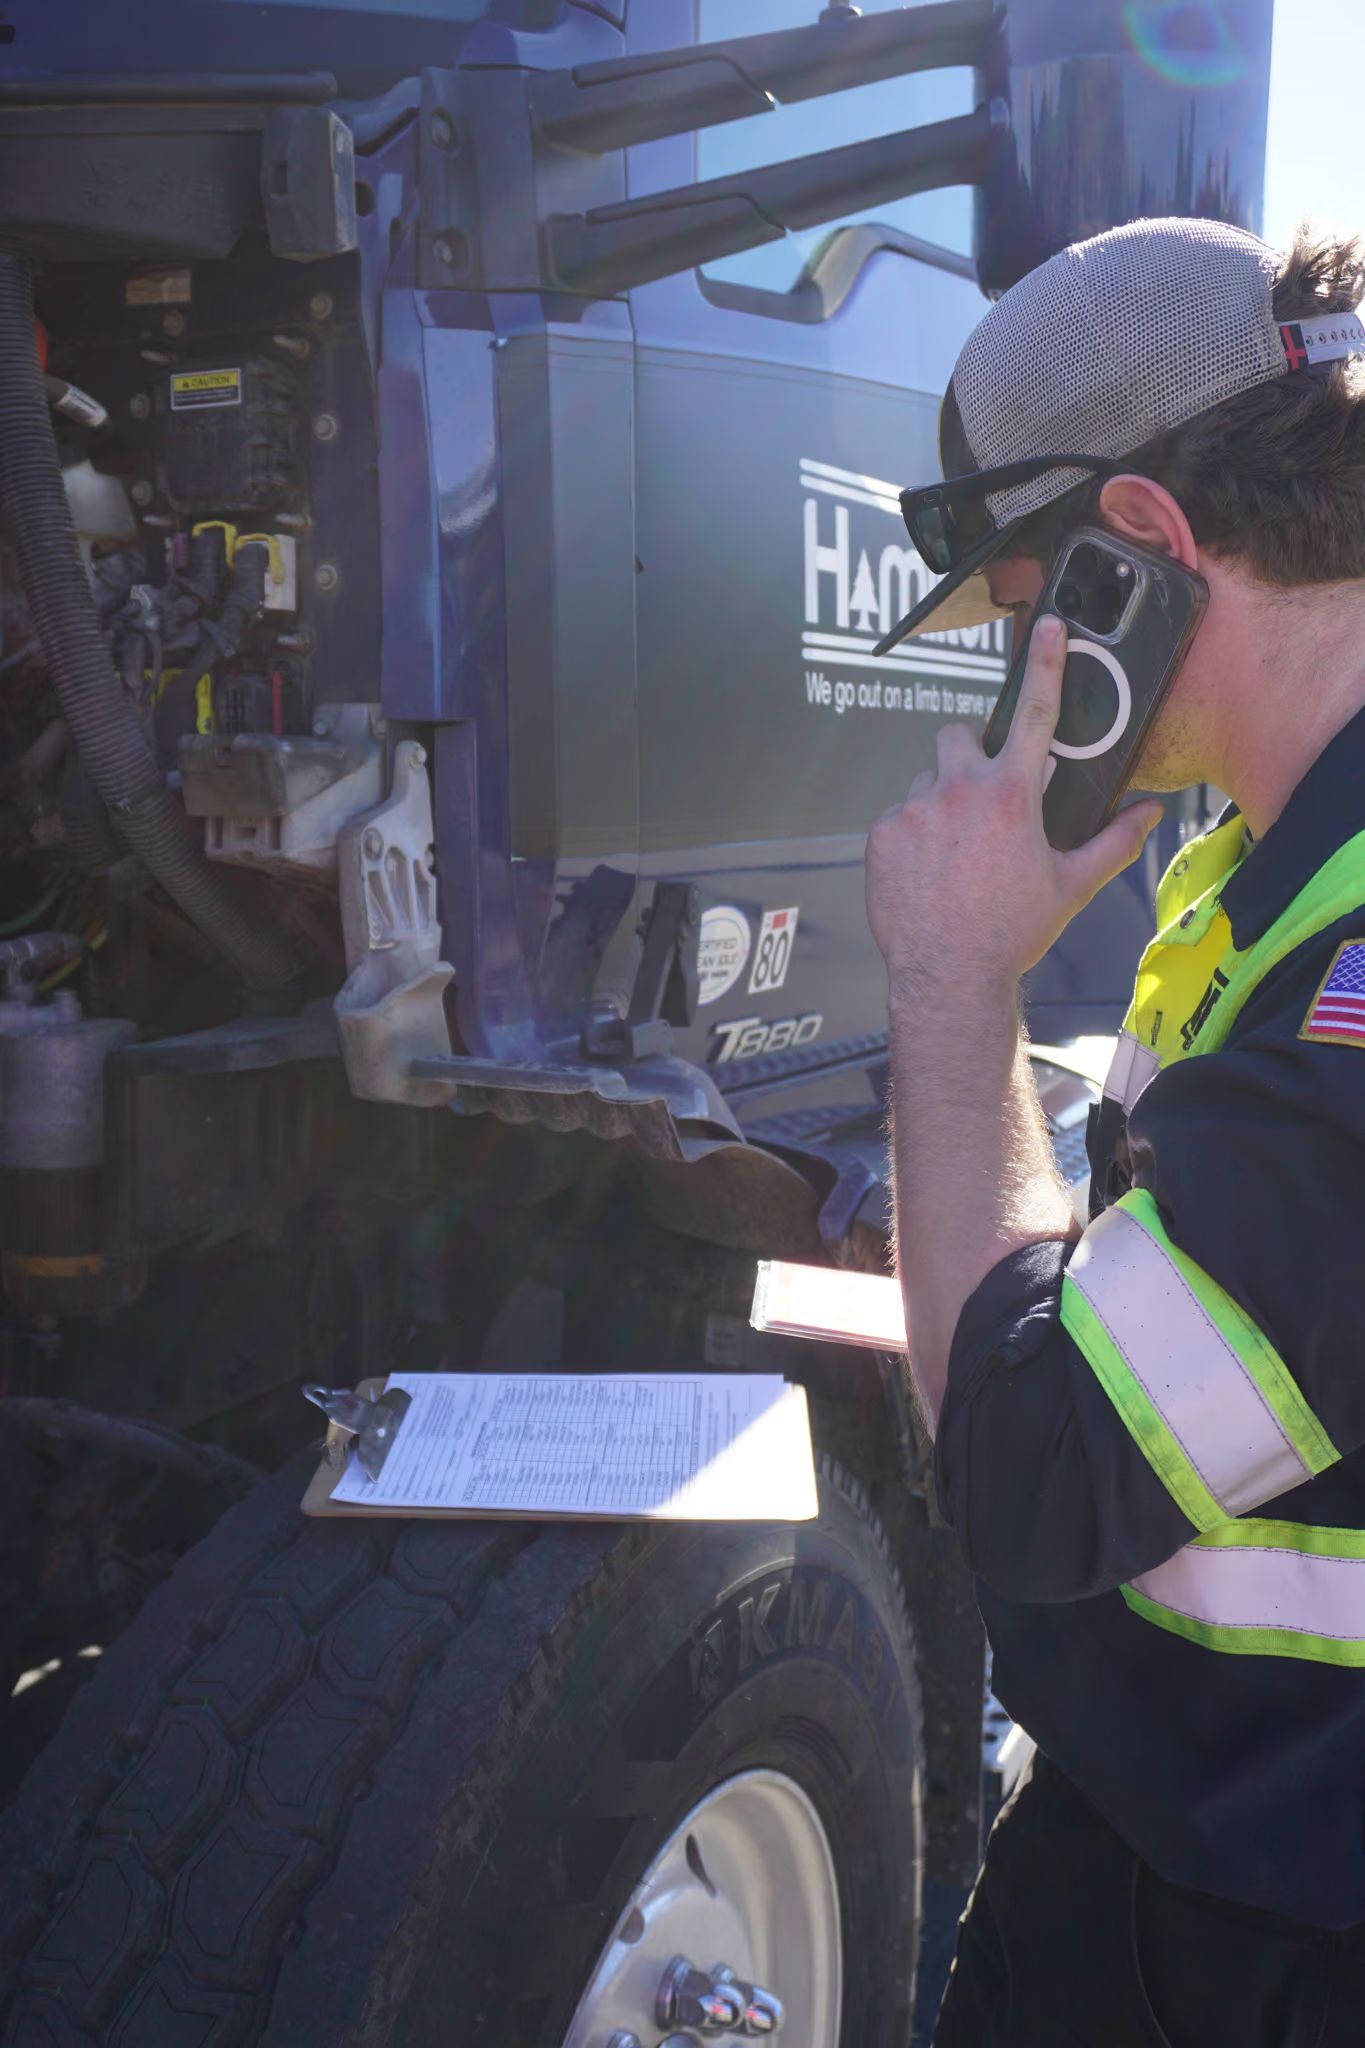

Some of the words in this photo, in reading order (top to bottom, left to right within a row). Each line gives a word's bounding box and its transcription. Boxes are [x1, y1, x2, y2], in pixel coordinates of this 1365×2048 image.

[191, 375, 230, 387] CAUTION
[805, 671, 832, 705] We
[834, 681, 855, 714] go
[858, 679, 881, 708] out
[884, 685, 902, 710] on
[904, 687, 913, 711] a
[914, 682, 940, 712] limb
[942, 684, 955, 713] to
[753, 930, 789, 988] 80
